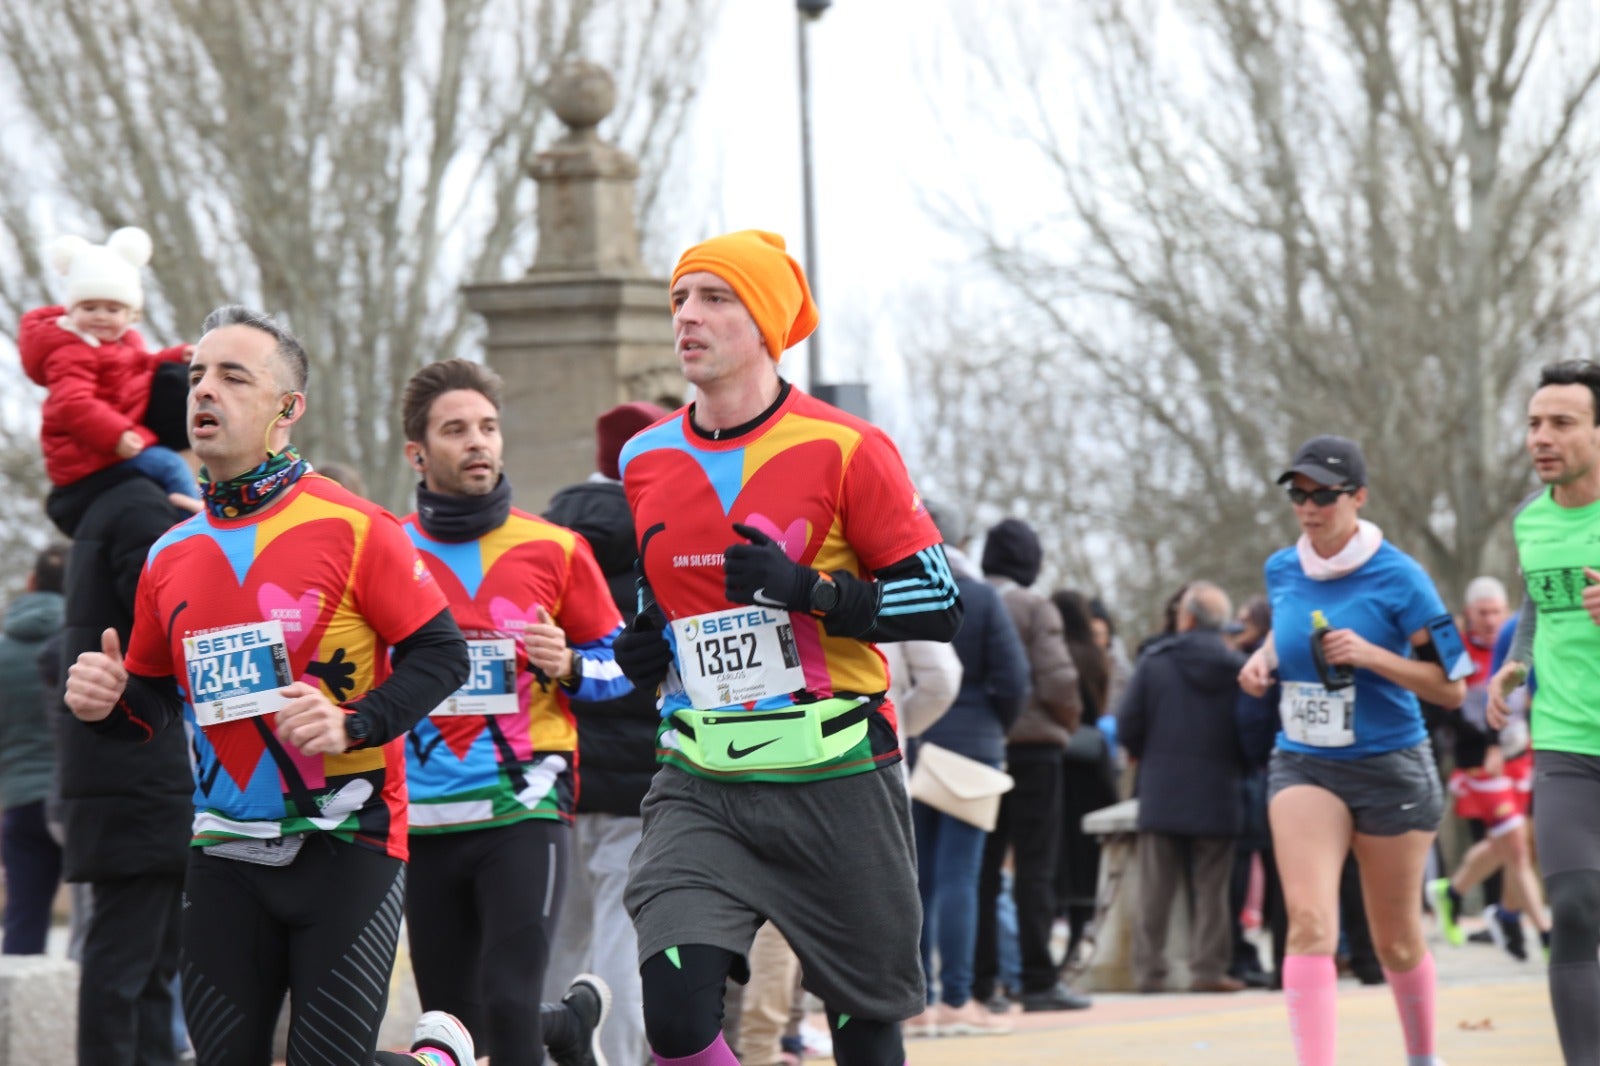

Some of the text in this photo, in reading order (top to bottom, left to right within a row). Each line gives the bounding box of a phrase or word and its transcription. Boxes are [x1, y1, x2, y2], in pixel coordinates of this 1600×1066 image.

[673, 554, 689, 568] SAN
[702, 610, 776, 635] SETEL
[197, 629, 271, 655] SETEL
[696, 632, 762, 677] 1352
[190, 651, 261, 696] 2344
[716, 671, 747, 682] CARLOS
